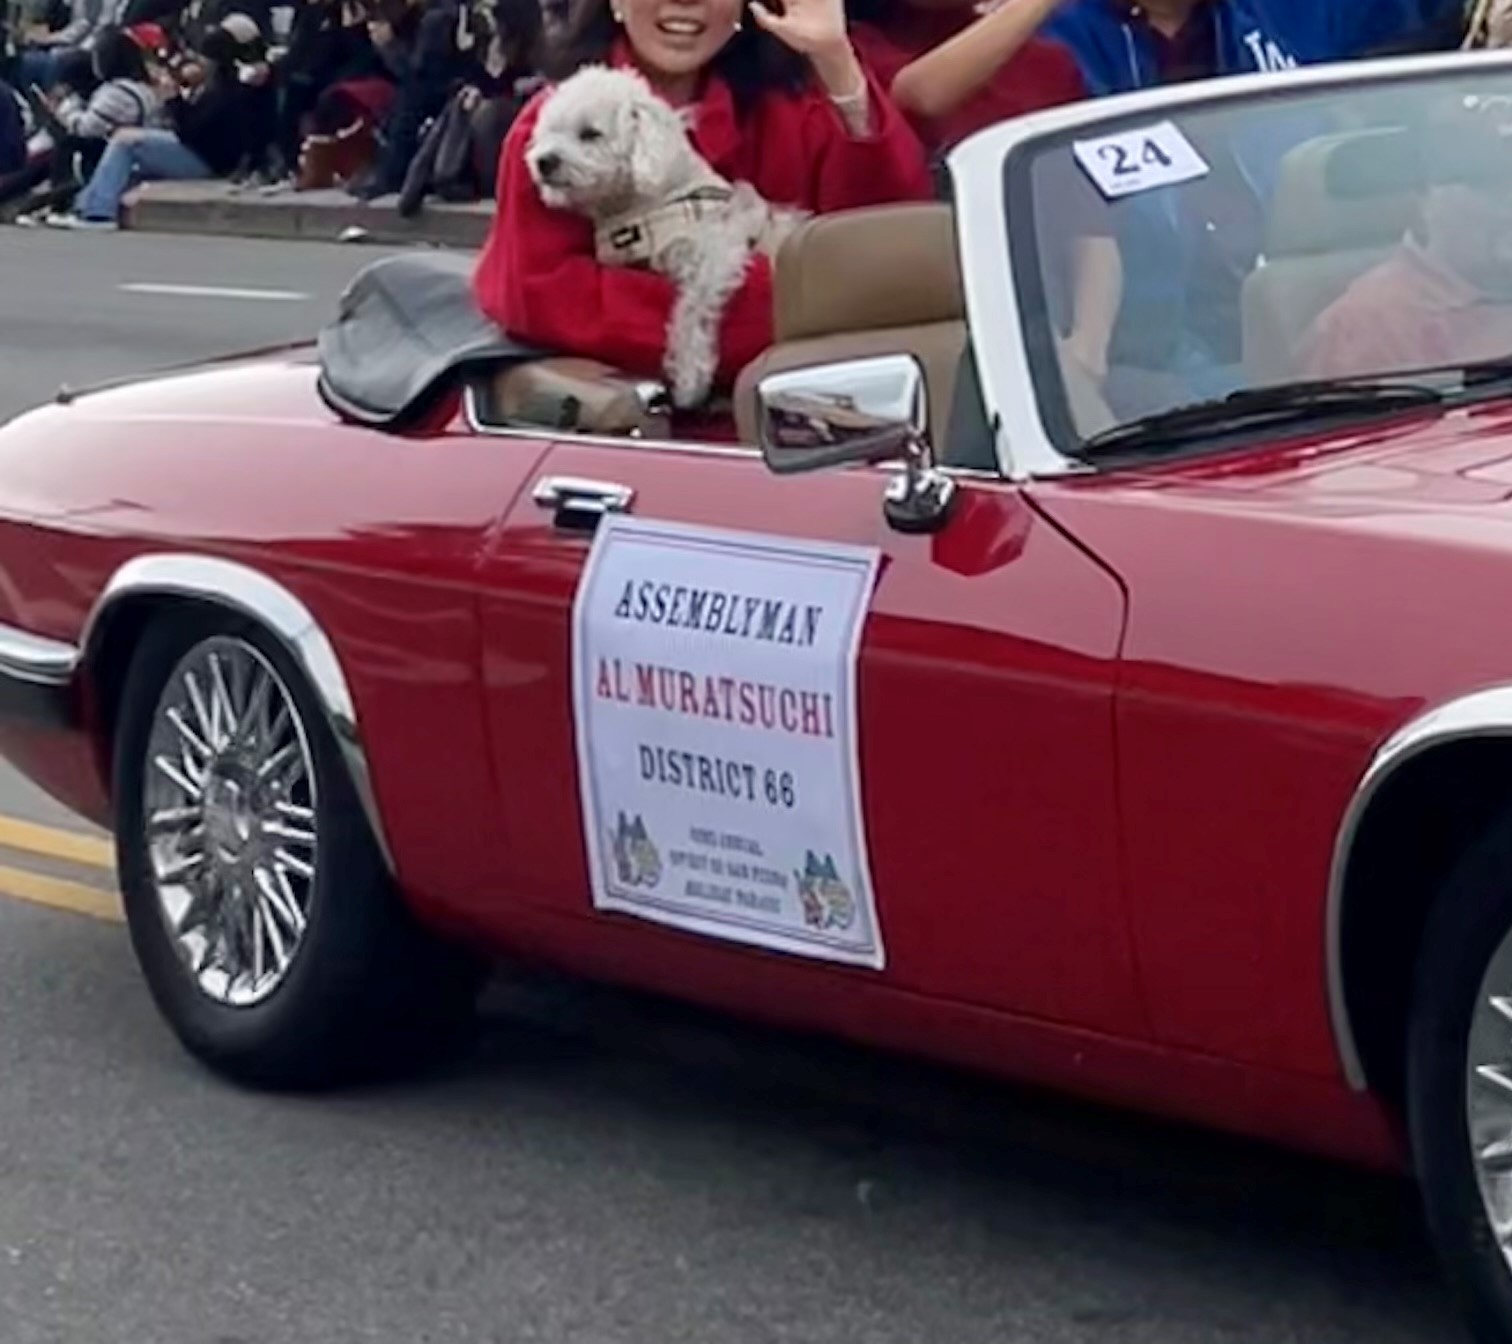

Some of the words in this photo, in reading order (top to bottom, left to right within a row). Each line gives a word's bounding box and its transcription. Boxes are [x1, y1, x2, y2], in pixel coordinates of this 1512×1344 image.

[1097, 137, 1173, 175] 24
[615, 579, 823, 646] ASSEMBLYMAN
[596, 657, 630, 703] AL
[636, 663, 835, 739] MURATSUCHI
[638, 744, 757, 802] DISTRICT
[763, 769, 796, 810] 66
